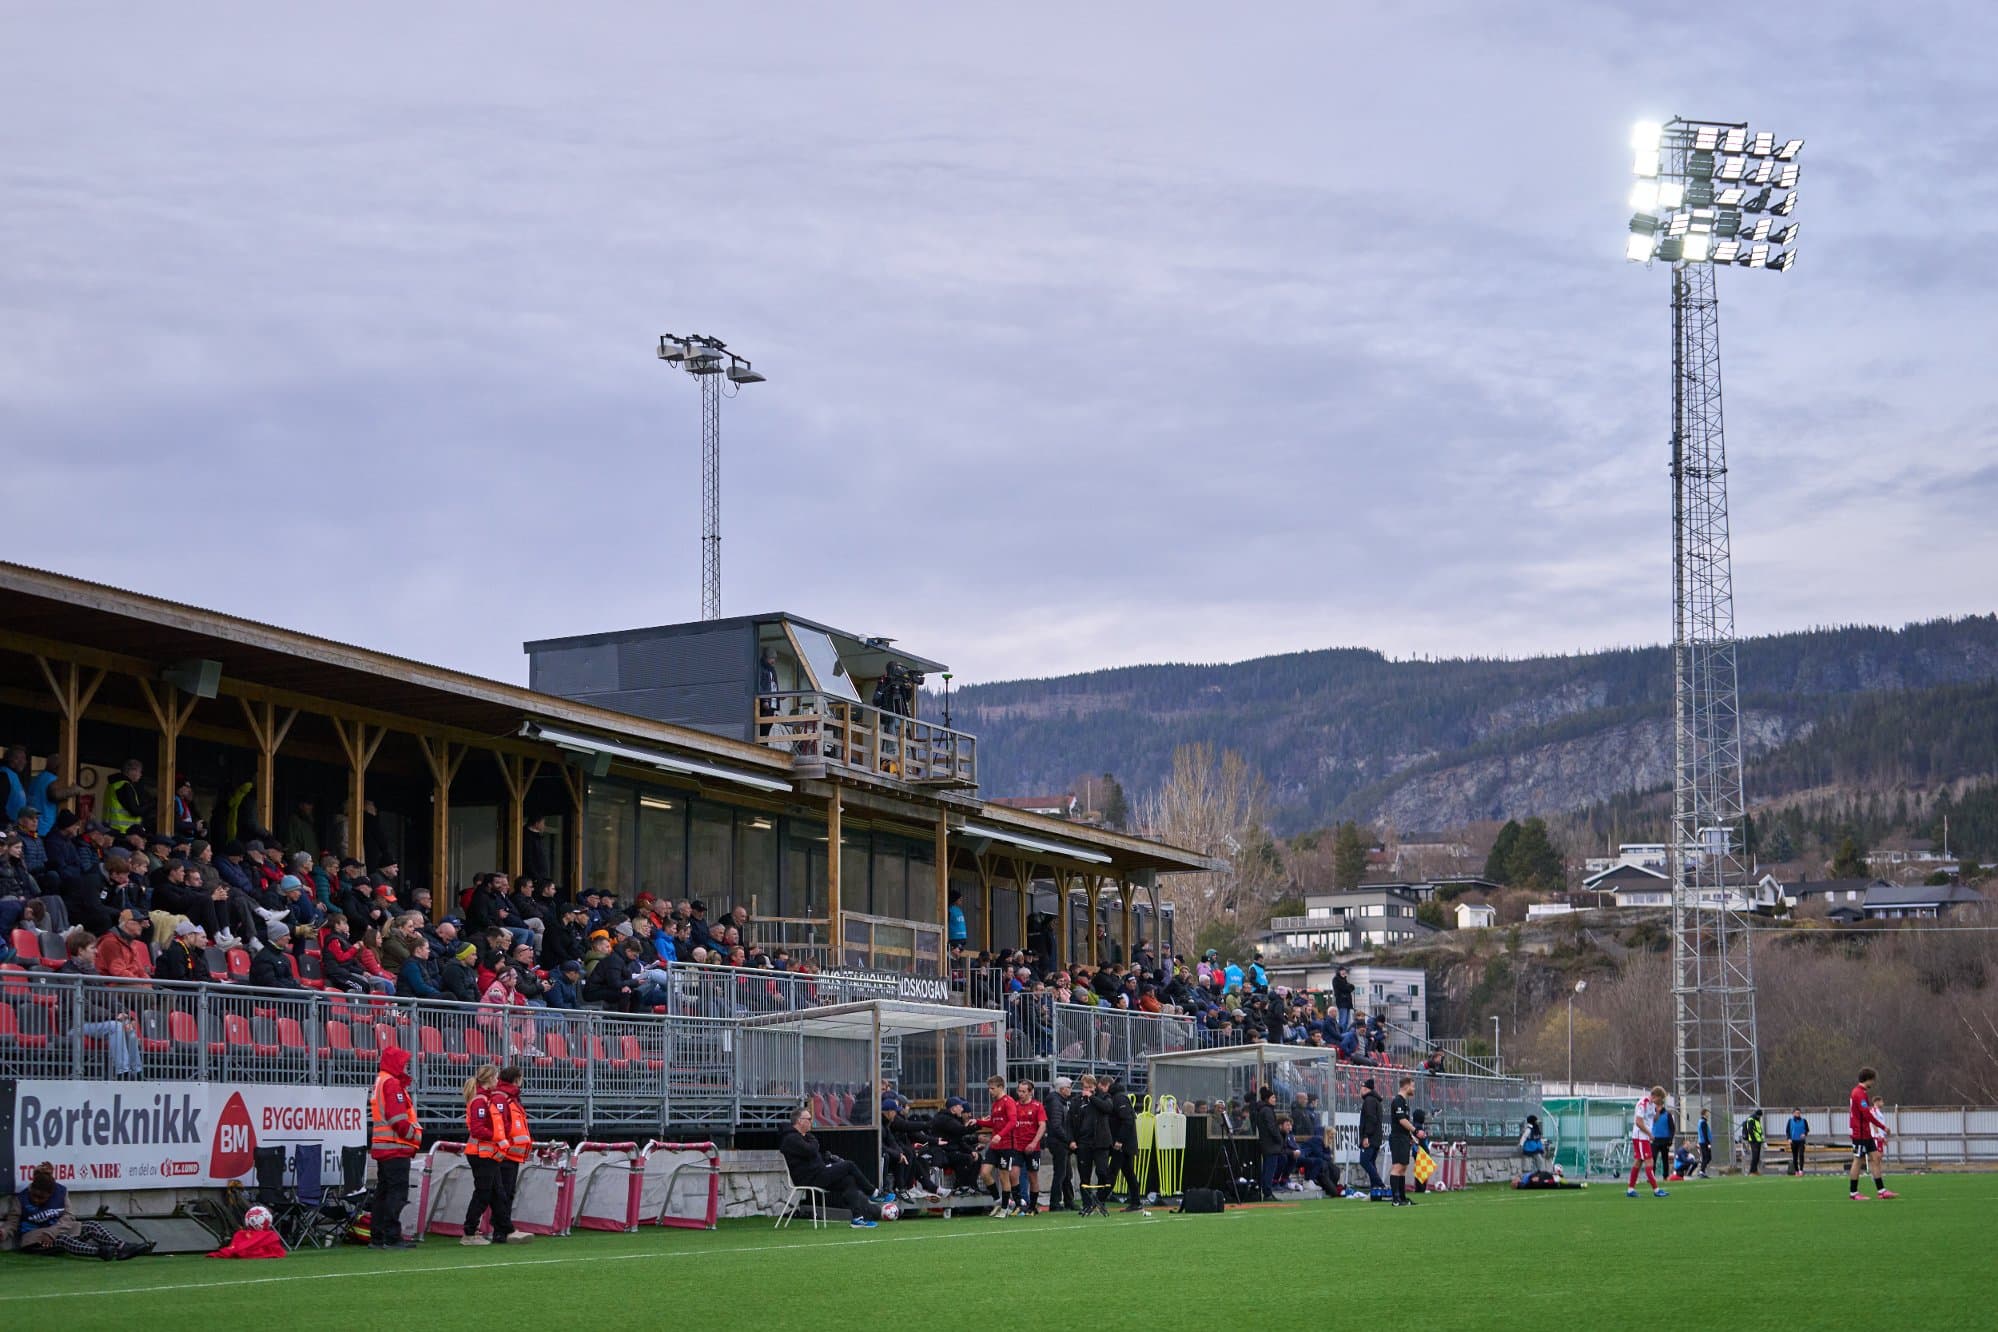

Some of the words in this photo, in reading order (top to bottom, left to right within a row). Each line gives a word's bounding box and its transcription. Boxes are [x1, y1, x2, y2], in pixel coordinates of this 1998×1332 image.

[20, 1093, 201, 1149] Rørteknikk
[263, 1107, 361, 1130] BYGGMAKKER
[221, 1125, 248, 1152] BM
[20, 1163, 76, 1181] TOIBA
[90, 1163, 121, 1179] NIBE
[129, 1166, 138, 1177] en
[138, 1163, 149, 1177] del
